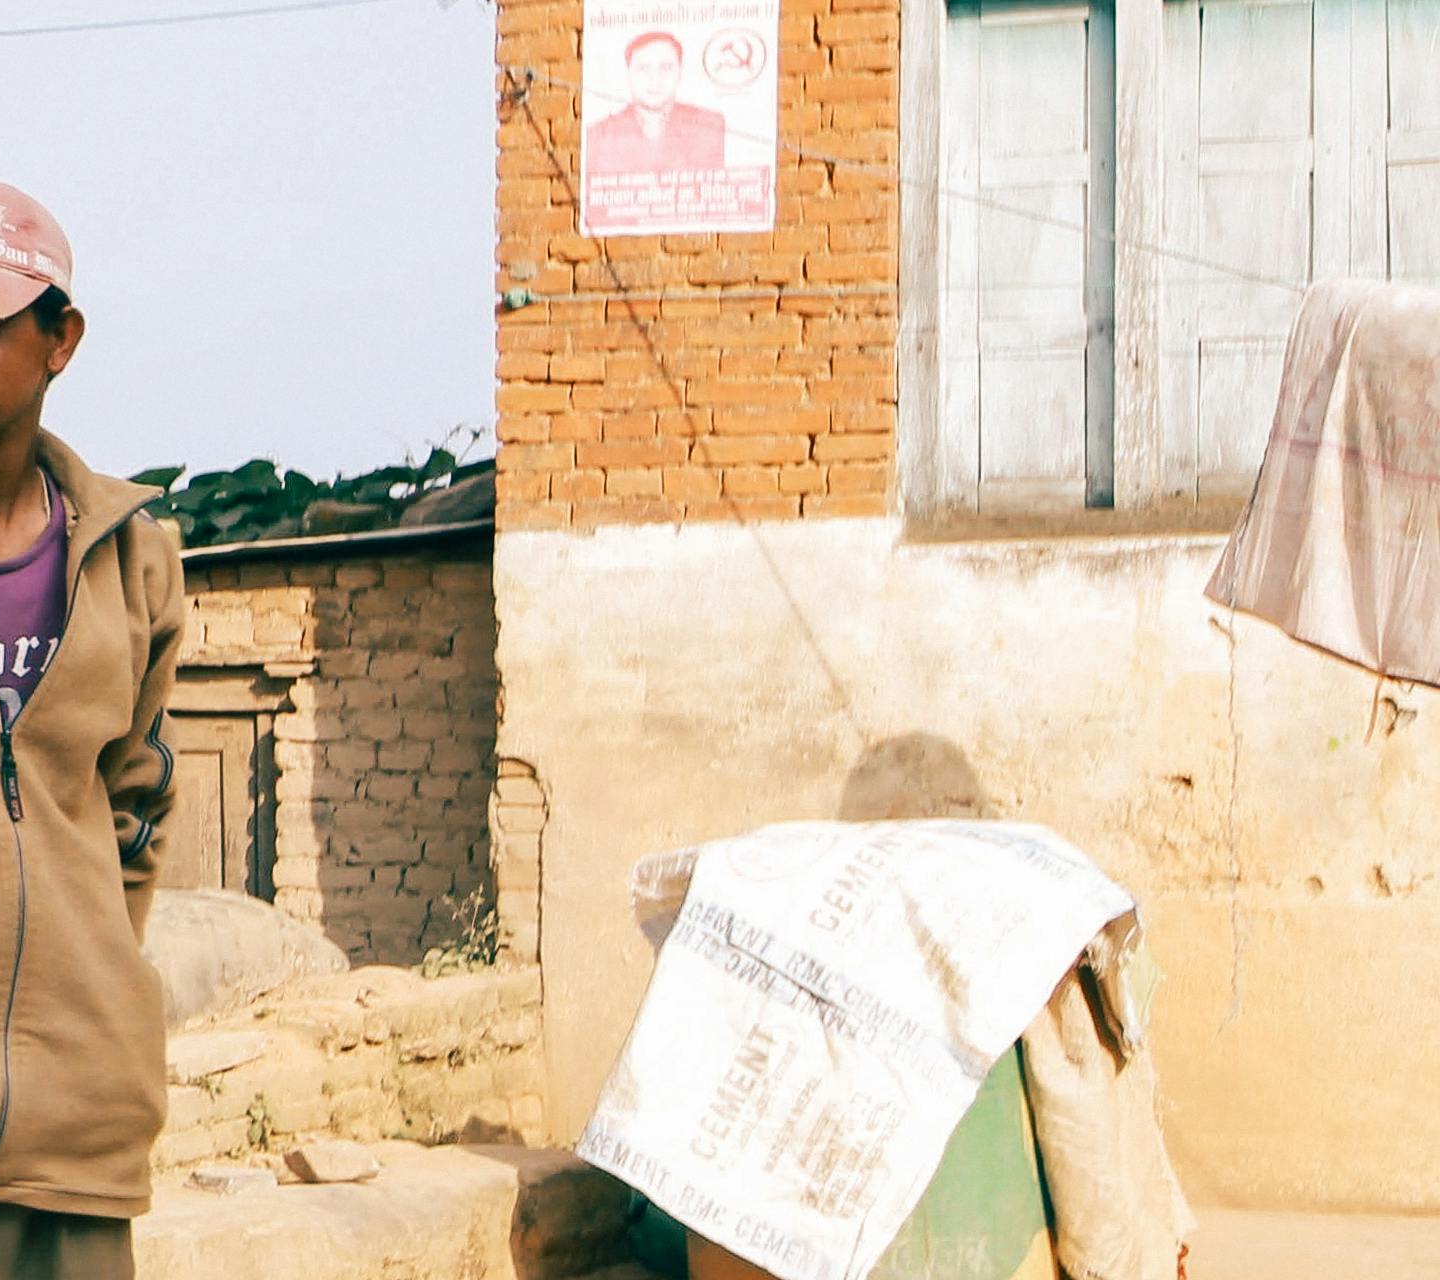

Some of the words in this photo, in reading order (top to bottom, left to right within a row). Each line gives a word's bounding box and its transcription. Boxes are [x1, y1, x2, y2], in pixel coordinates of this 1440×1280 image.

[723, 952, 778, 995] RMC
[785, 949, 835, 996] RMC
[689, 1021, 778, 1161] CEMENT
[590, 1131, 671, 1192] CEMENT
[681, 1183, 728, 1226] RMC
